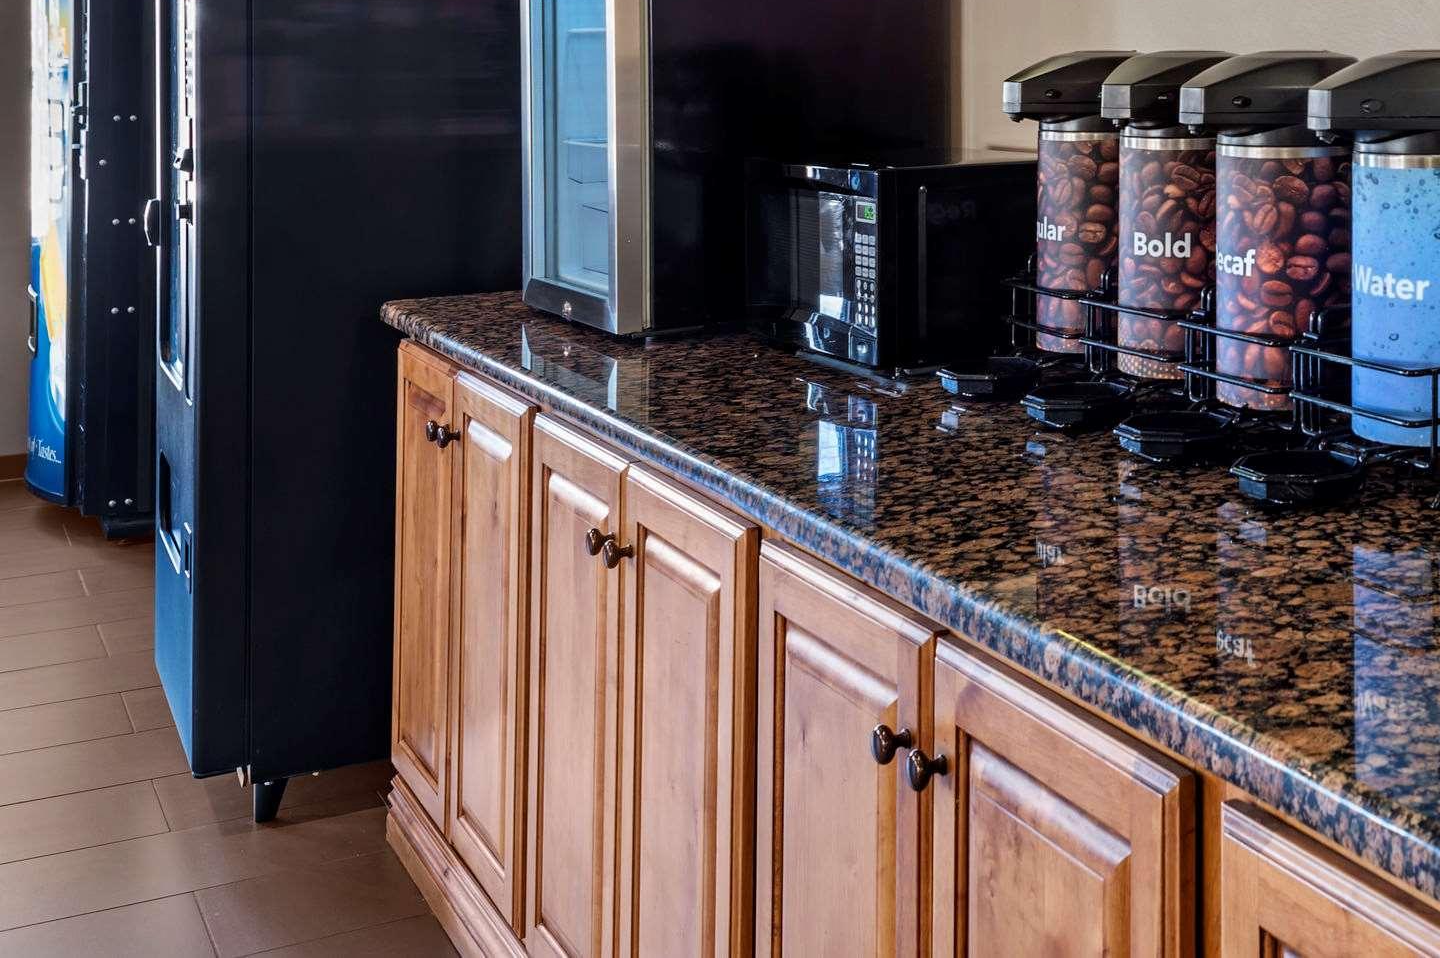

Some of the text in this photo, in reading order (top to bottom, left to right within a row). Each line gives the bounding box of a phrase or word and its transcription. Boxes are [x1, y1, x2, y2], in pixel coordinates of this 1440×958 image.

[1037, 216, 1066, 242] ular
[1134, 232, 1191, 258] Bold
[1216, 248, 1256, 277] ecaf
[1354, 263, 1430, 301] Water
